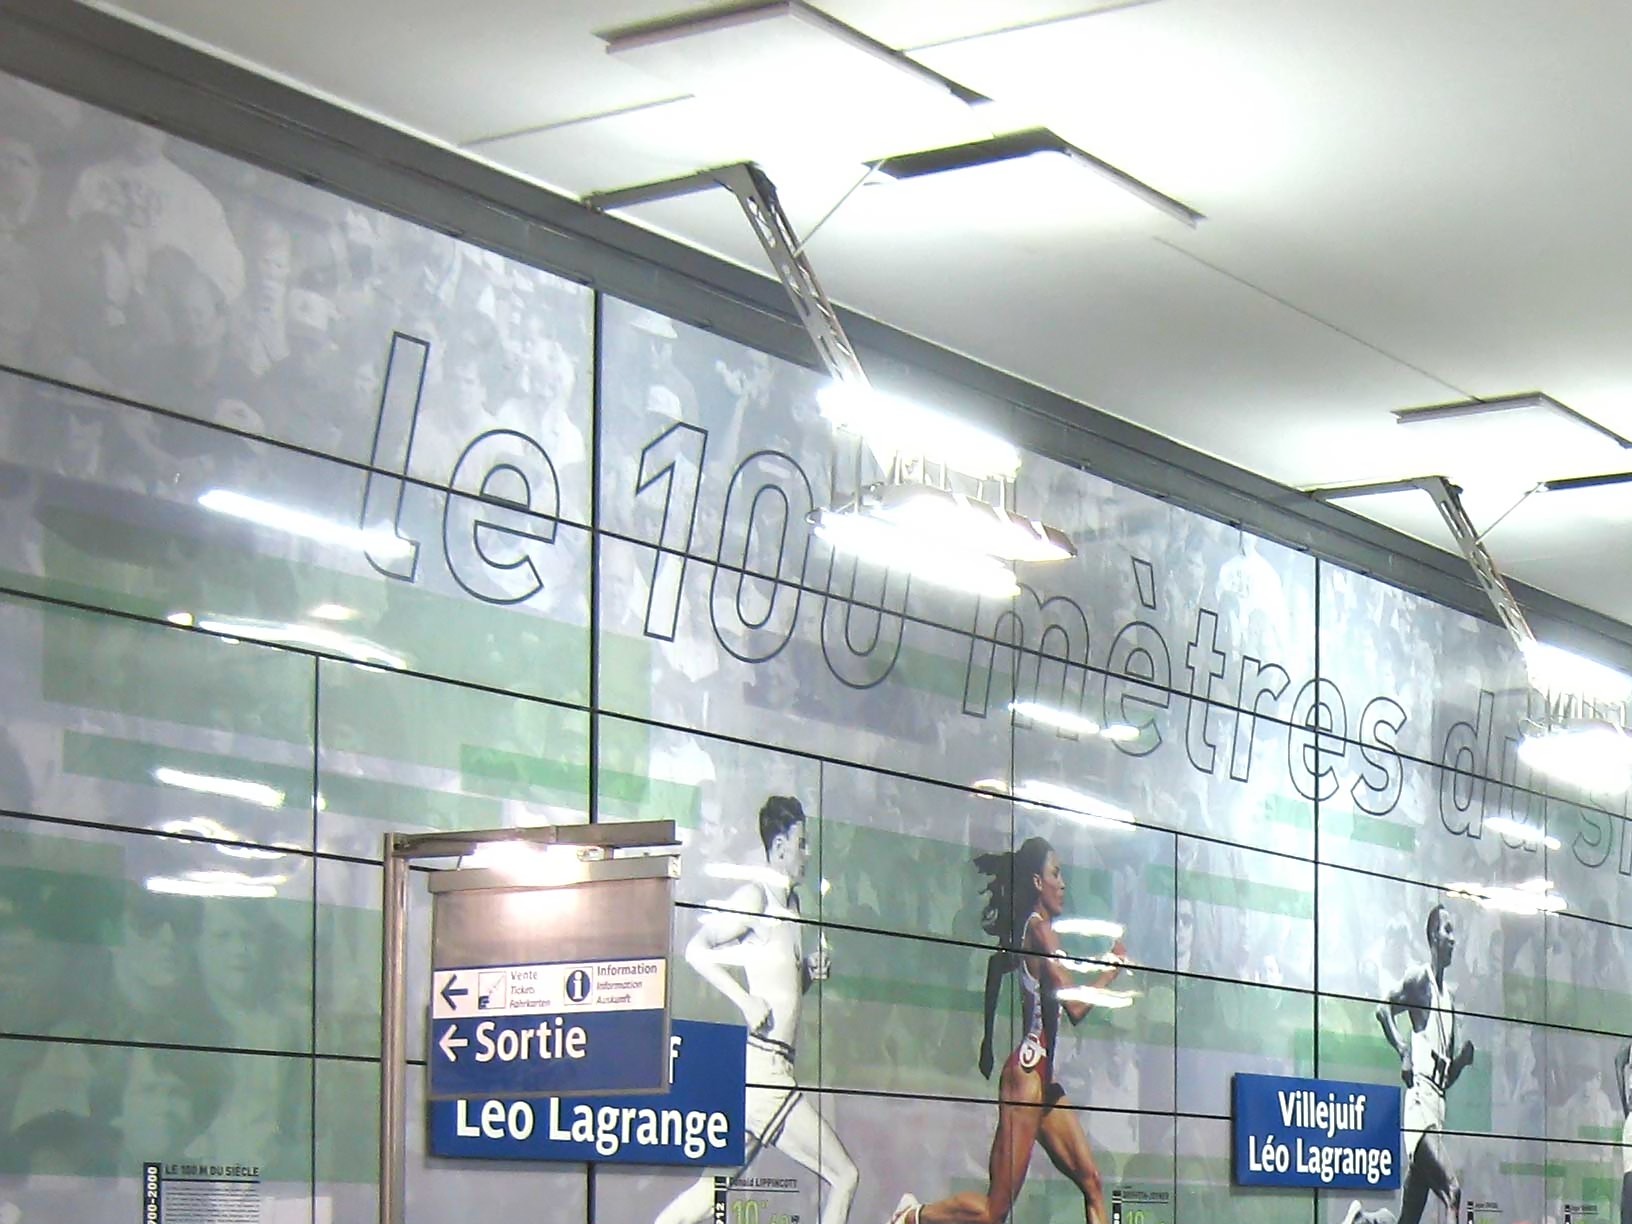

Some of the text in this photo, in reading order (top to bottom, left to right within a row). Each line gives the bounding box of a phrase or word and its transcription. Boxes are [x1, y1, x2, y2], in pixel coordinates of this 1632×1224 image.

[359, 331, 560, 605] le
[961, 556, 1407, 817] mètres
[597, 963, 658, 976] Information
[475, 1016, 588, 1063] Sortie
[549, 1096, 729, 1159] Lagrange
[1277, 1090, 1367, 1139] Villejuif
[210, 1166, 224, 1177] DU
[225, 1163, 260, 1178] SIÈCLE
[1248, 1134, 1393, 1185] Léo Lagrange
